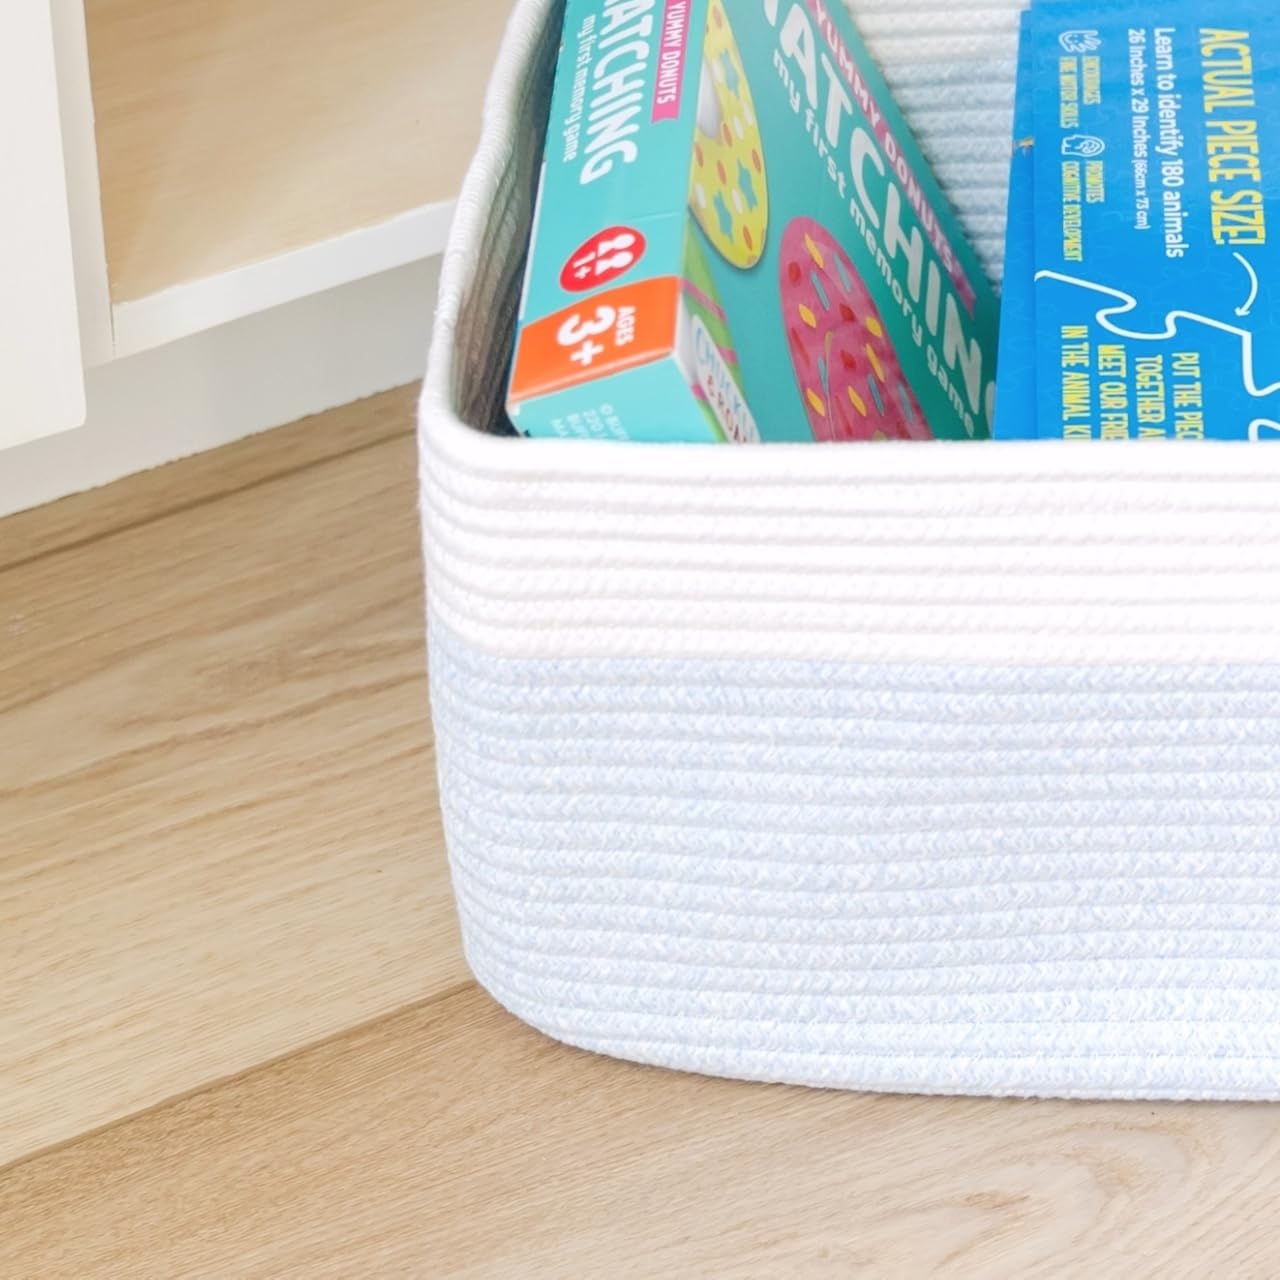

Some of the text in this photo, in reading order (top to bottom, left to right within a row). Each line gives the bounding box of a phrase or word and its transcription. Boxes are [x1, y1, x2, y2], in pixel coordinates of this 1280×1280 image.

[577, 14, 596, 38] my
[1128, 28, 1146, 44] 26
[577, 36, 598, 66] first
[656, 0, 687, 105] YUMMY DONUTS
[1129, 46, 1148, 85] Inches
[566, 67, 589, 122] memory
[1131, 97, 1150, 113] 29
[1132, 115, 1151, 157] Inches
[1154, 27, 1190, 258] Learn to identify 180 animals
[1199, 27, 1266, 245] ACTUAL PIECE SIZE!
[884, 131, 955, 274] DONUTS
[774, 48, 975, 438] my first memory game
[573, 252, 596, 279] 1+
[556, 305, 616, 366] 3+
[615, 306, 636, 347] AGES
[1061, 325, 1088, 339] IN
[1061, 342, 1089, 368] THE
[1098, 344, 1127, 378] MEET
[1062, 371, 1091, 421] ANIMAL
[1099, 381, 1128, 409] OUR
[1135, 354, 1165, 423] TOGETHER
[1171, 352, 1204, 440] PUT THE PIEC
